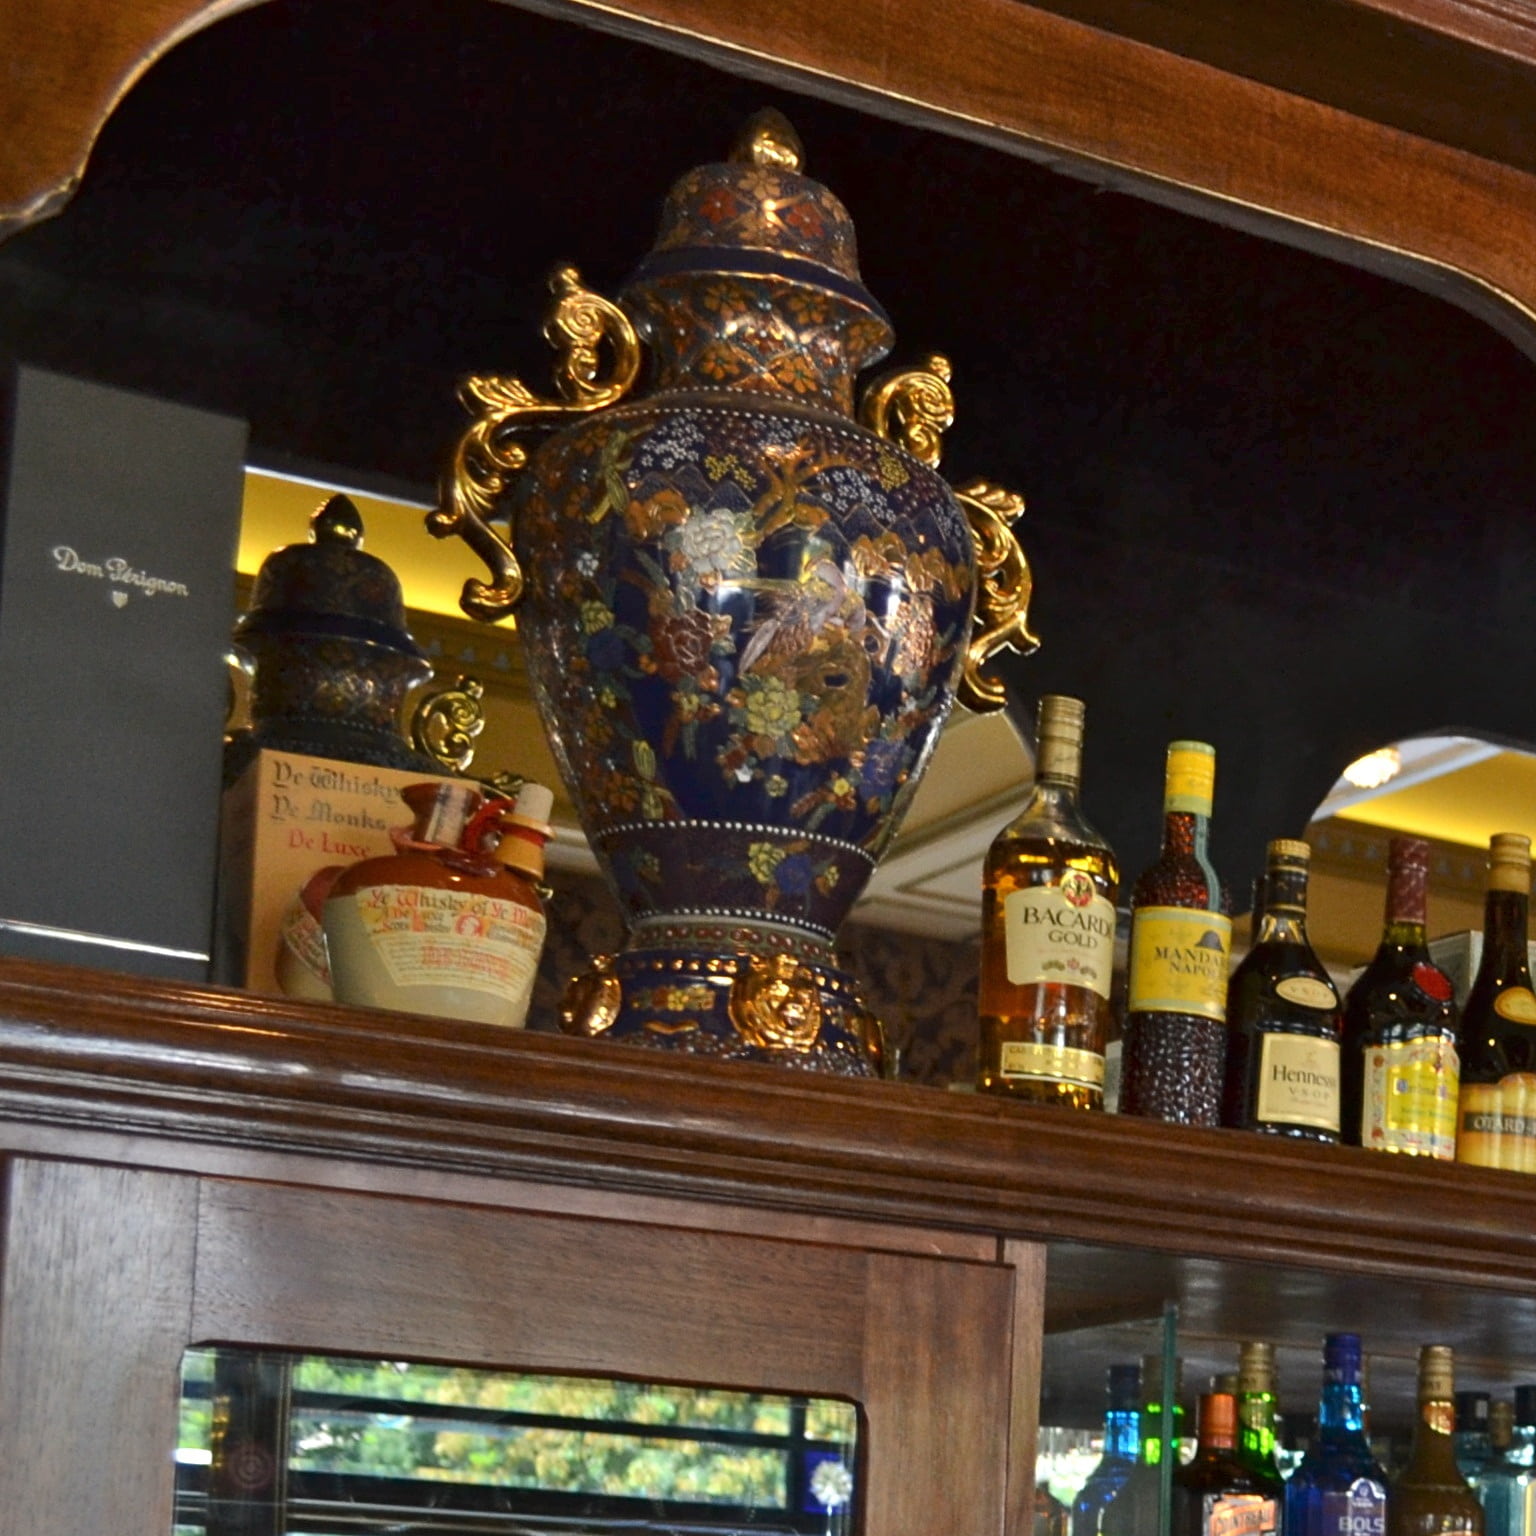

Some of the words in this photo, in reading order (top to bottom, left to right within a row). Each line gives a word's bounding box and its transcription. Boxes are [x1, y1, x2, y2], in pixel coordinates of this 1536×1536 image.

[53, 546, 104, 577] Dom
[1048, 930, 1099, 949] GOLD
[1154, 945, 1226, 967] MANDA
[1169, 961, 1218, 977] NAPO
[1272, 1064, 1338, 1088] Henness
[1338, 1516, 1385, 1533] BOLS
